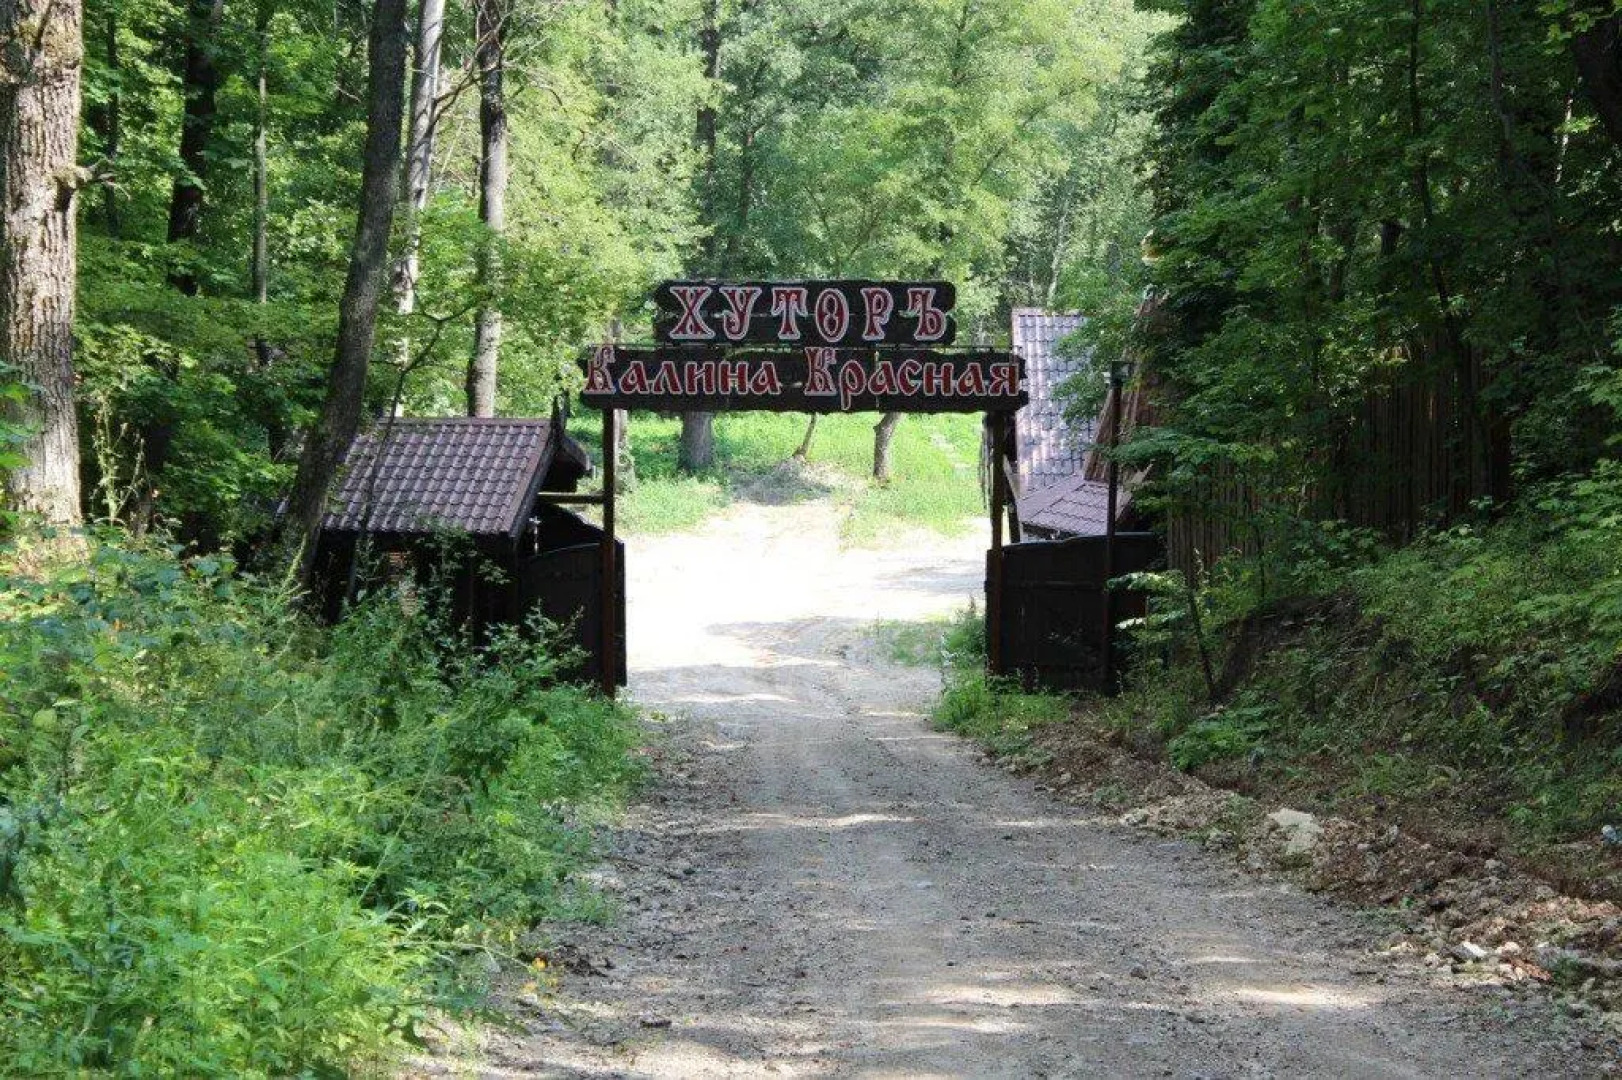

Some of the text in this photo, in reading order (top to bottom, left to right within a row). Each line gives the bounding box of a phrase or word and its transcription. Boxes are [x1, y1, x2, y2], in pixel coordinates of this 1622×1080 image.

[668, 285, 948, 343] ХУТОРЪ
[583, 344, 1021, 411] Калина Красная
